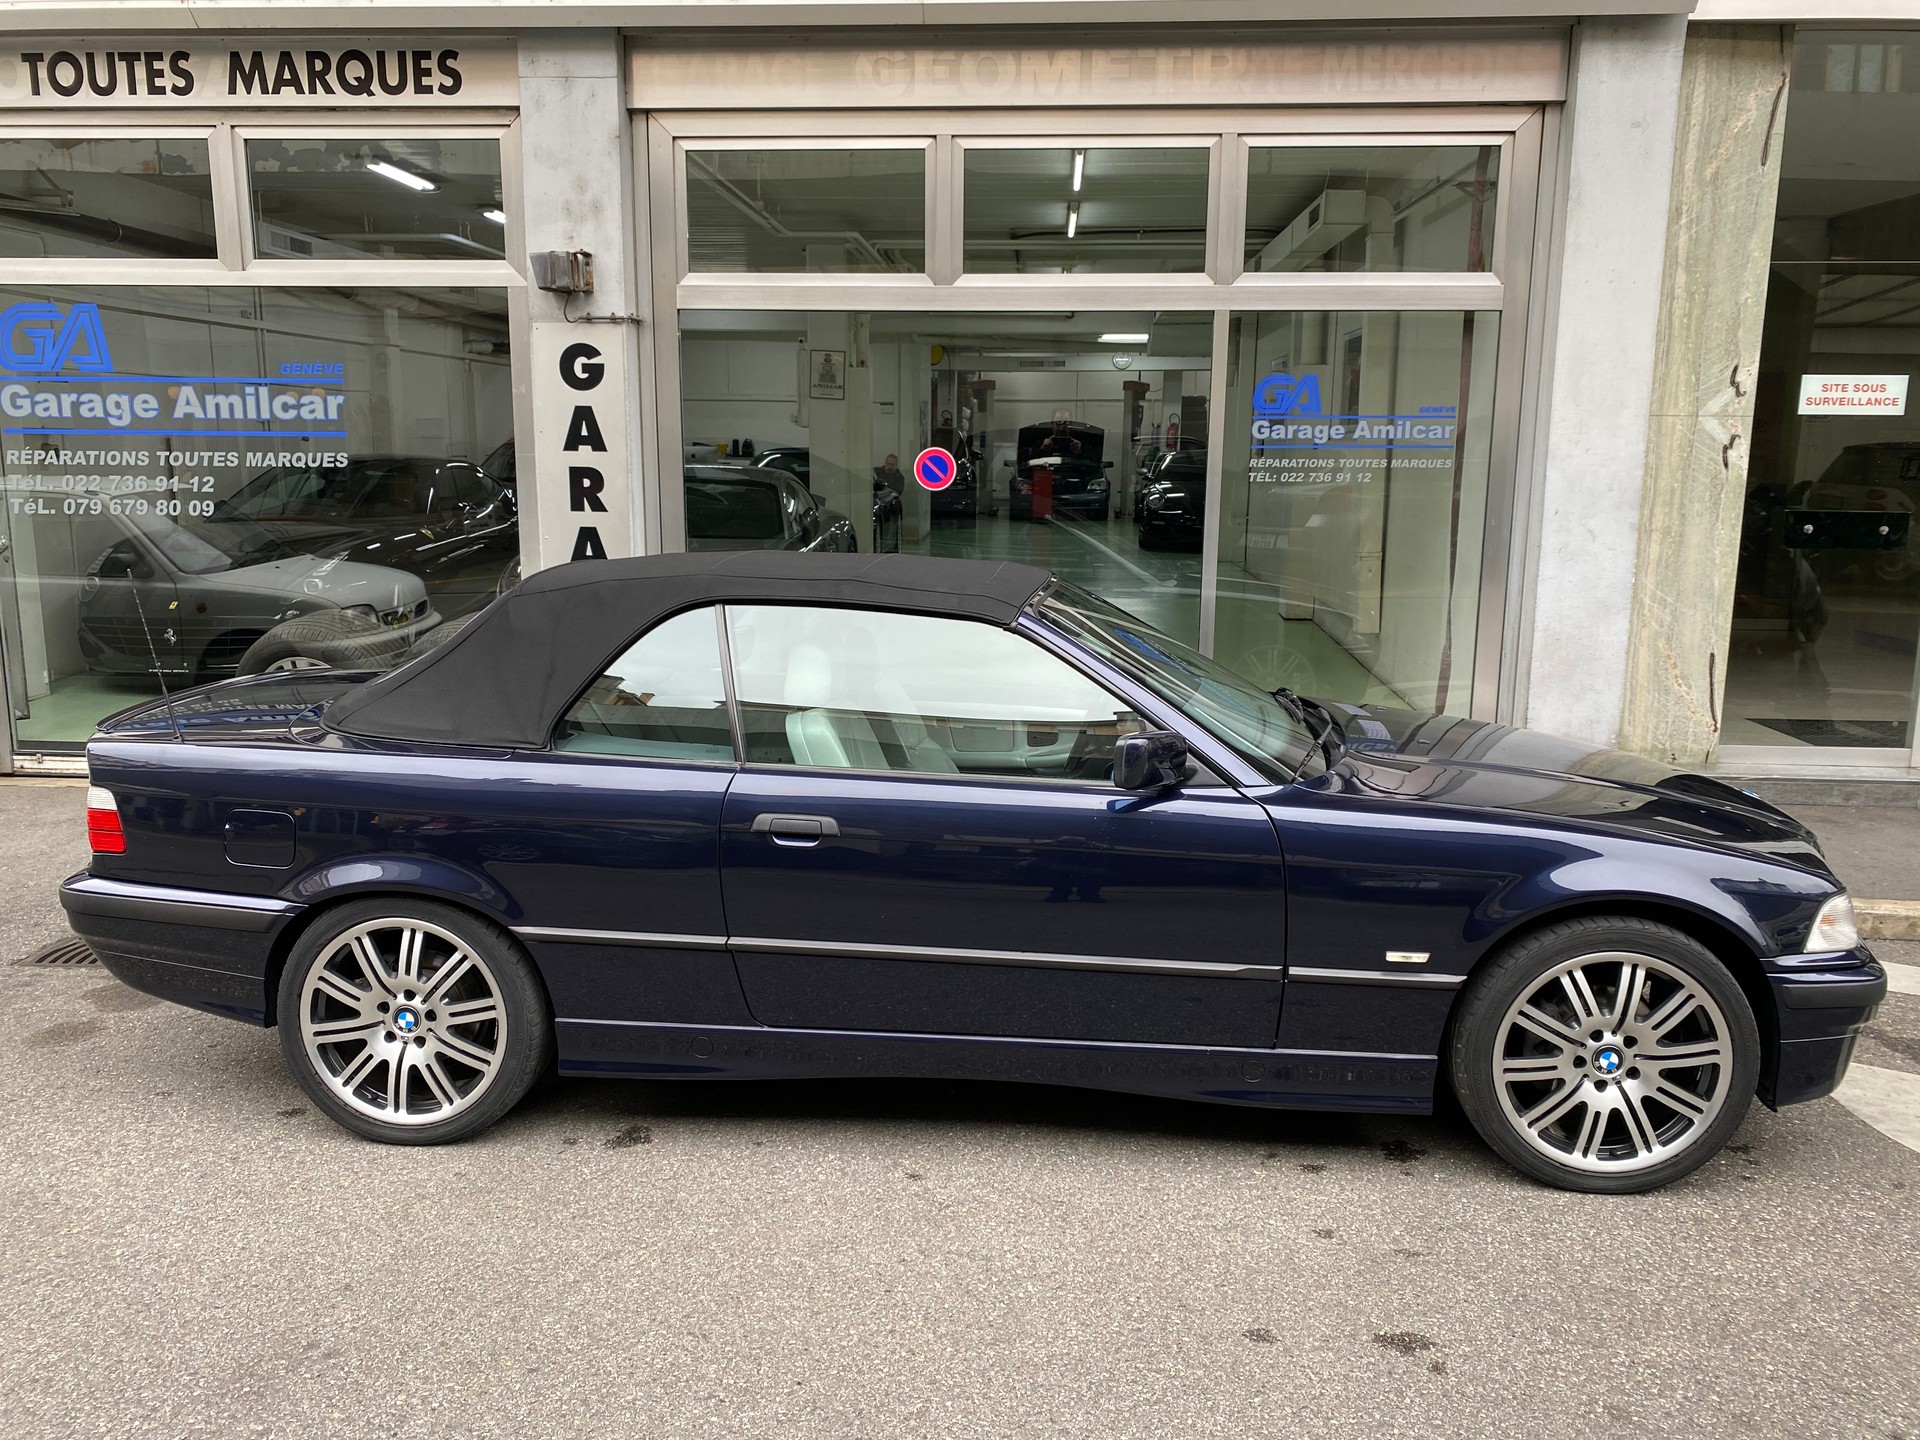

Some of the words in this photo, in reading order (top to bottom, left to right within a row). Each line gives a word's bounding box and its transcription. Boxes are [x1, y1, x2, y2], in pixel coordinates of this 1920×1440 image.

[21, 50, 195, 97] TOUTES
[227, 49, 463, 98] MARQUES
[0, 302, 114, 372] GA
[279, 362, 344, 375] GENÈVE
[1253, 374, 1322, 414] GA
[1821, 384, 1849, 393] SITE
[1853, 384, 1887, 393] SOUS
[1, 384, 159, 427] Garage
[173, 386, 344, 420] Amilcar
[1806, 397, 1900, 406] SURVEILLANCE
[1251, 420, 1345, 443] Garage
[1353, 420, 1455, 439] Amilcar
[6, 447, 149, 466] RÉPARATIONS
[157, 452, 239, 467] TOUTES
[245, 452, 349, 469] MARQUES
[1250, 456, 1334, 467] RÉPARATIONS
[1339, 459, 1387, 467] TOUTES
[1391, 459, 1452, 468] MARQUES
[62, 475, 99, 491] 022
[108, 475, 147, 492] 736
[155, 475, 181, 492] 91
[189, 476, 214, 492] 12
[1249, 471, 1276, 482] TÉL:
[1280, 473, 1304, 482] 022
[1309, 473, 1332, 482] 736
[1336, 473, 1350, 482] 91
[1356, 473, 1371, 482] 12
[63, 499, 102, 515] 079
[109, 499, 148, 516] 679
[155, 500, 181, 516] 80
[188, 500, 215, 516] 09
